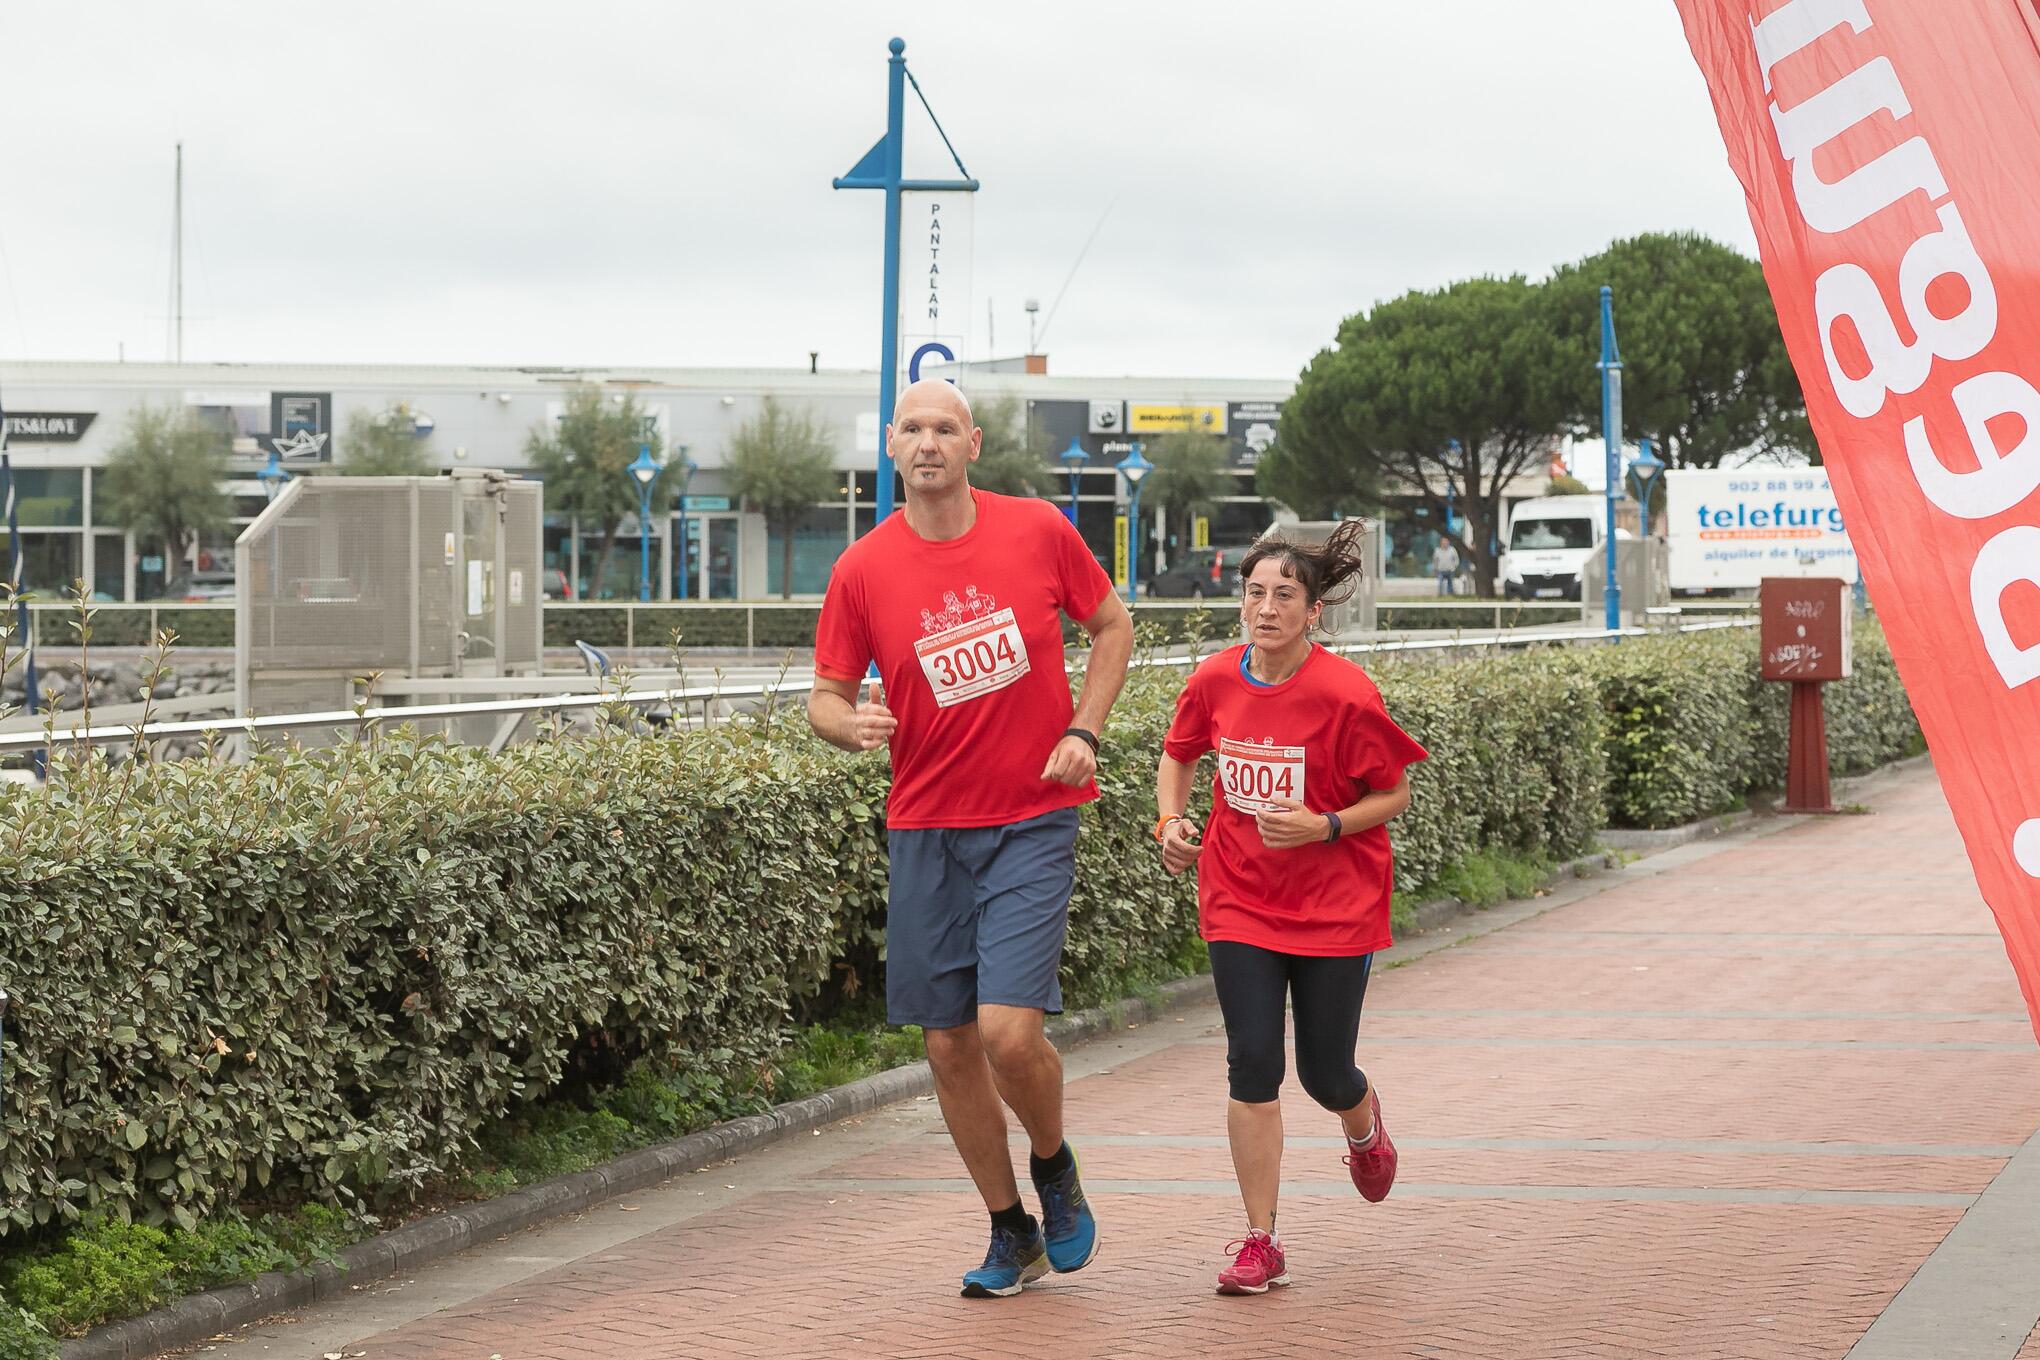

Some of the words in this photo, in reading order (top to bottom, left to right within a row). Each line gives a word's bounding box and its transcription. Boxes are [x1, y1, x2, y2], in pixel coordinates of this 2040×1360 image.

[928, 203, 941, 319] PANTALAN
[1728, 480, 1760, 492] 902
[1767, 480, 1787, 492] 88
[1793, 479, 1814, 491] 99
[1697, 501, 1846, 532] telefurg
[1704, 549, 1763, 561] alquiler
[1769, 547, 1788, 558] de
[933, 633, 1017, 687] 3004
[1226, 760, 1293, 799] 3004
